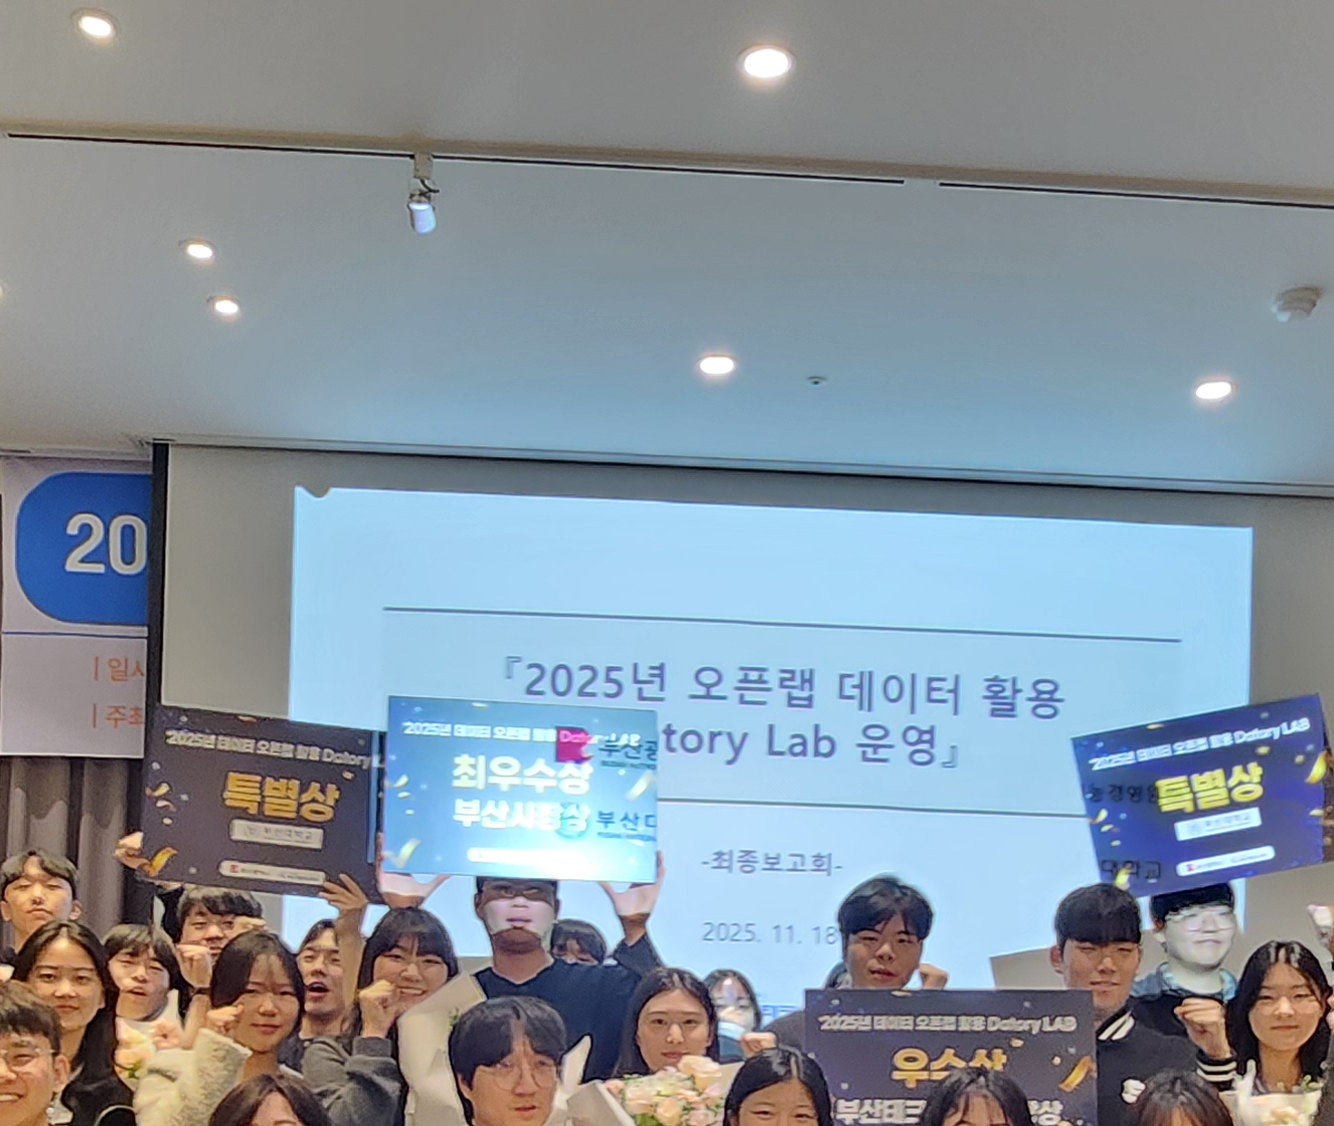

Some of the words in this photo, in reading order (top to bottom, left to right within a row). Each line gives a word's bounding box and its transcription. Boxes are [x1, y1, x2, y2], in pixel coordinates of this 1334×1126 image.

[64, 512, 147, 576] 20
[688, 666, 815, 709] 오픈랩
[838, 670, 960, 716] 데이터
[982, 674, 1065, 720] 활용
[662, 723, 749, 765] tory
[767, 723, 837, 759] Lab
[223, 771, 340, 823] 특별상
[452, 753, 593, 795] 최우수상
[1156, 761, 1264, 813] 특별상
[702, 921, 762, 943] 2025.
[772, 925, 802, 944] 11.
